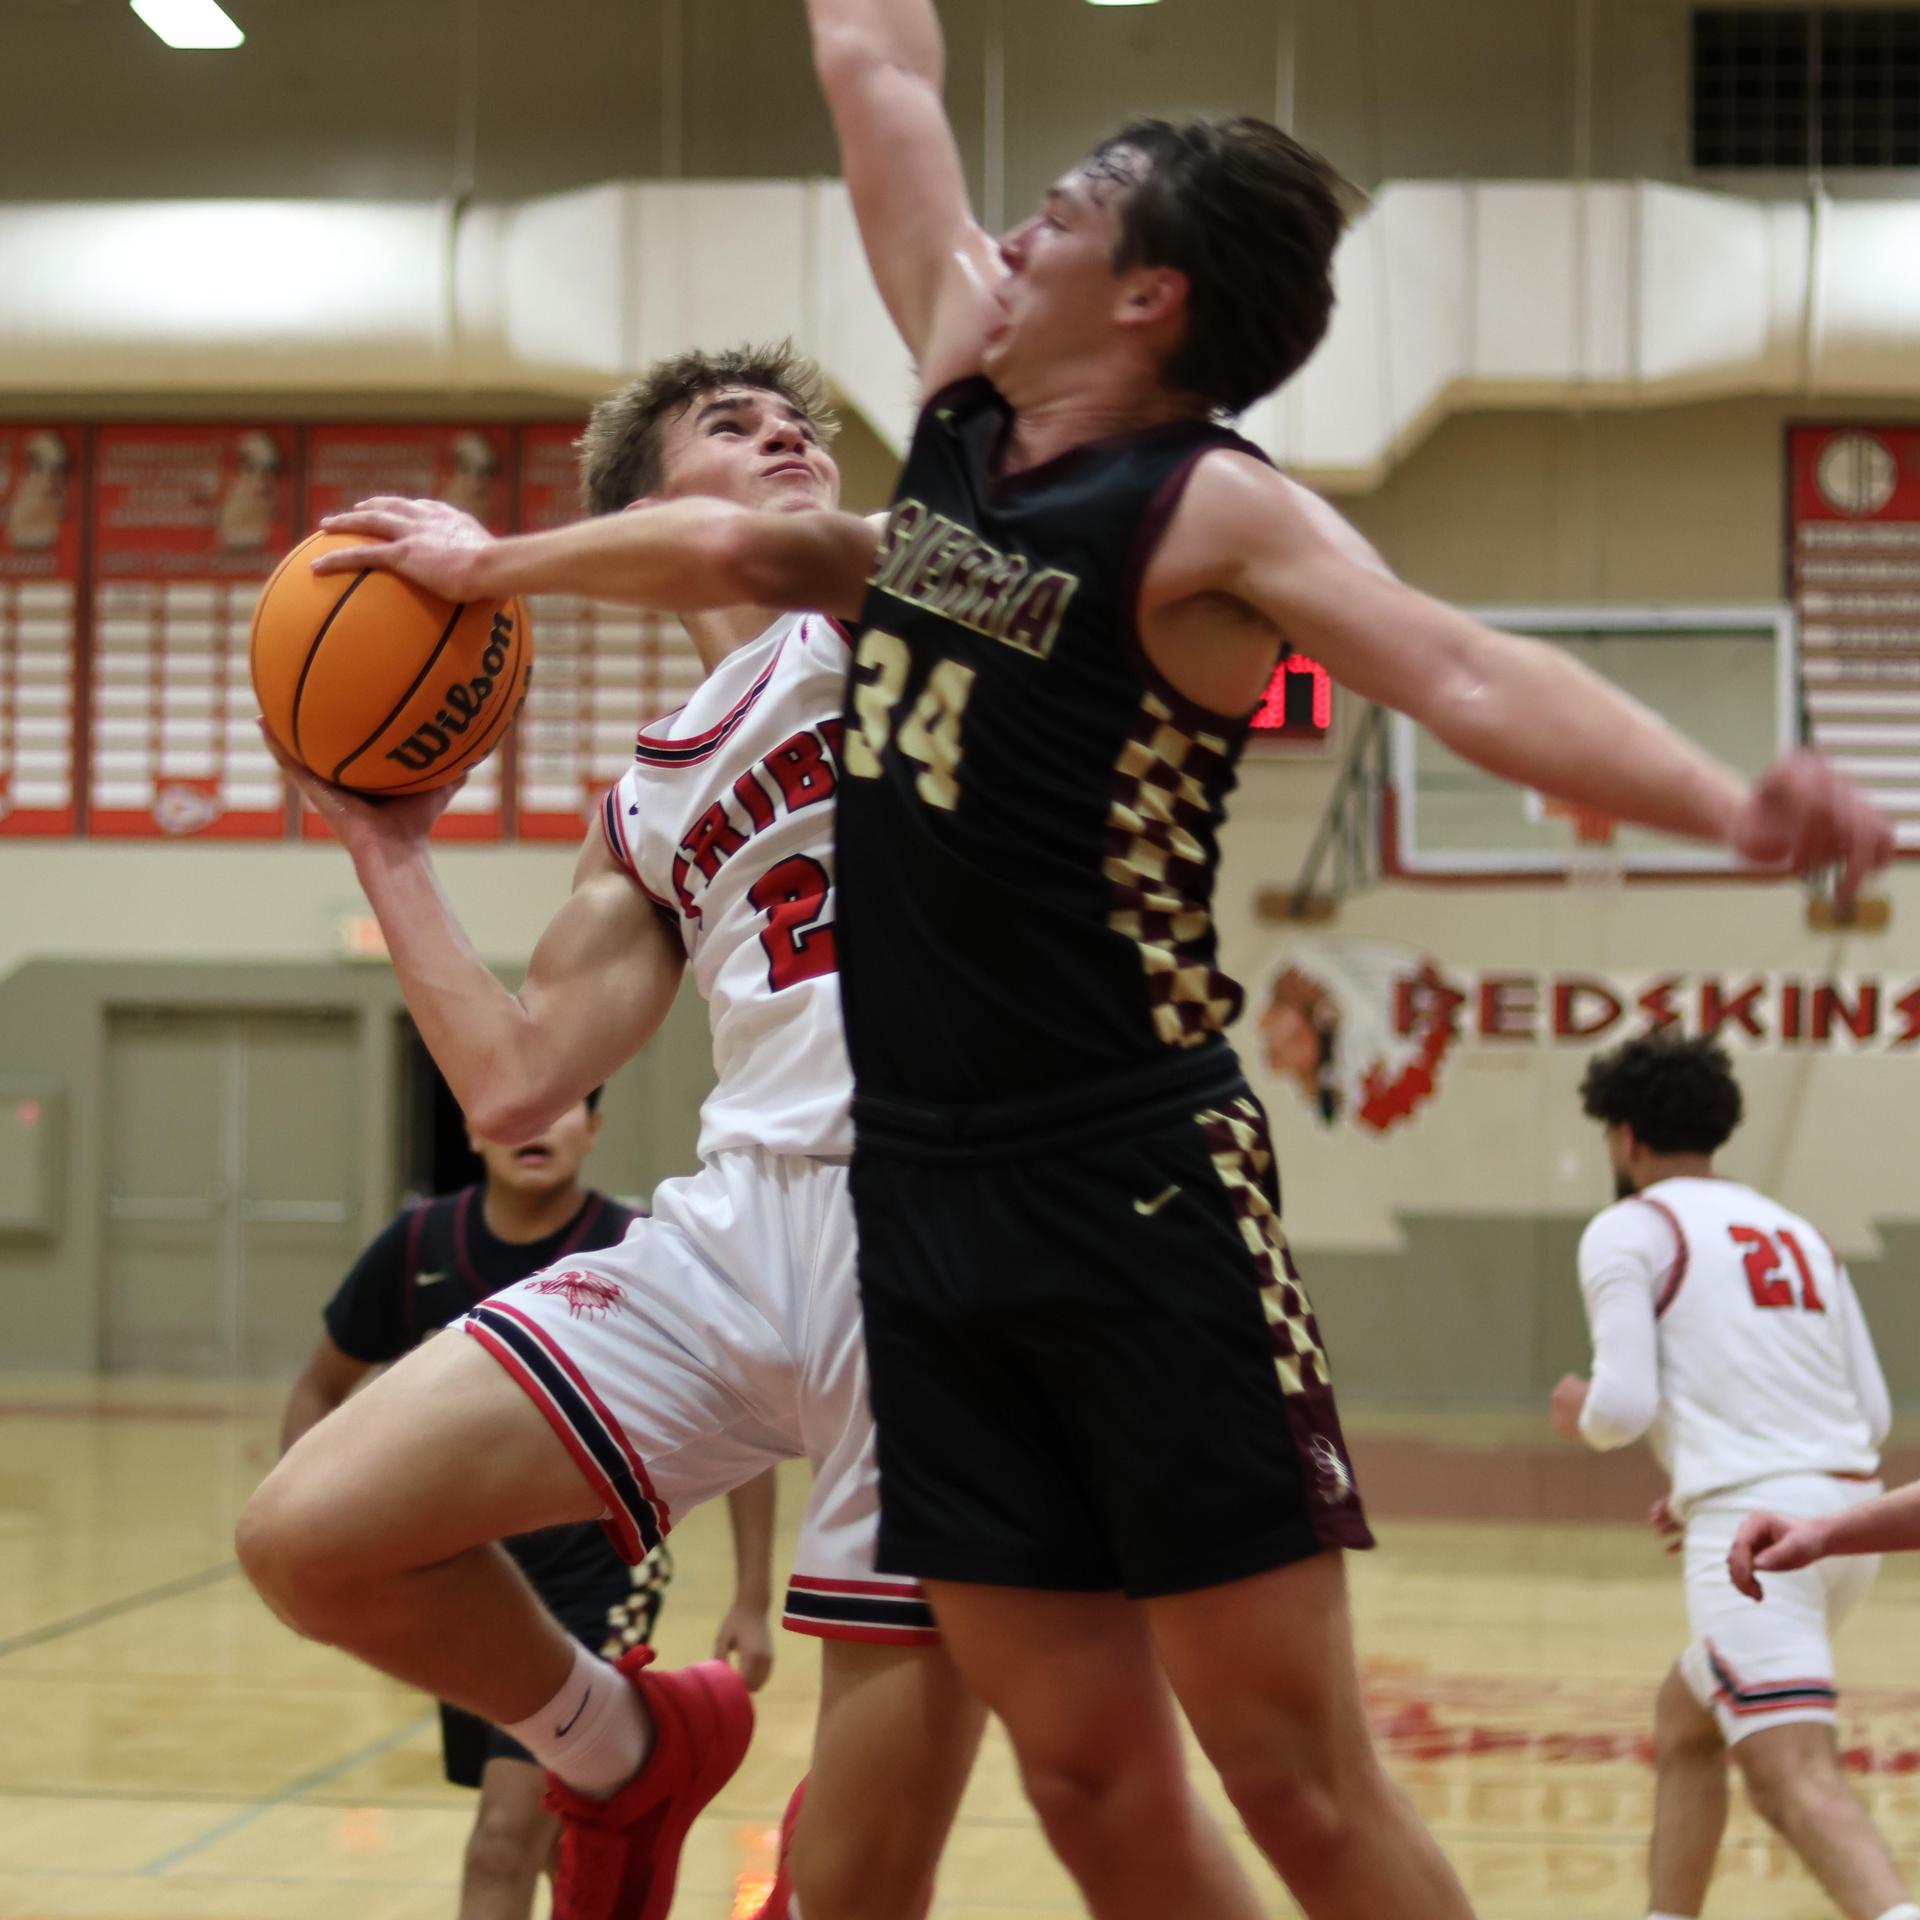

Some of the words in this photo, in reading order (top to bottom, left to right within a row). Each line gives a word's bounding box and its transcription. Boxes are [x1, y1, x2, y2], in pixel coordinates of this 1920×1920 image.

[866, 498, 1080, 660] SIERRA
[385, 612, 513, 770] Wilson
[844, 628, 976, 812] 34
[747, 853, 839, 994] 2
[1728, 1225, 1826, 1314] 21
